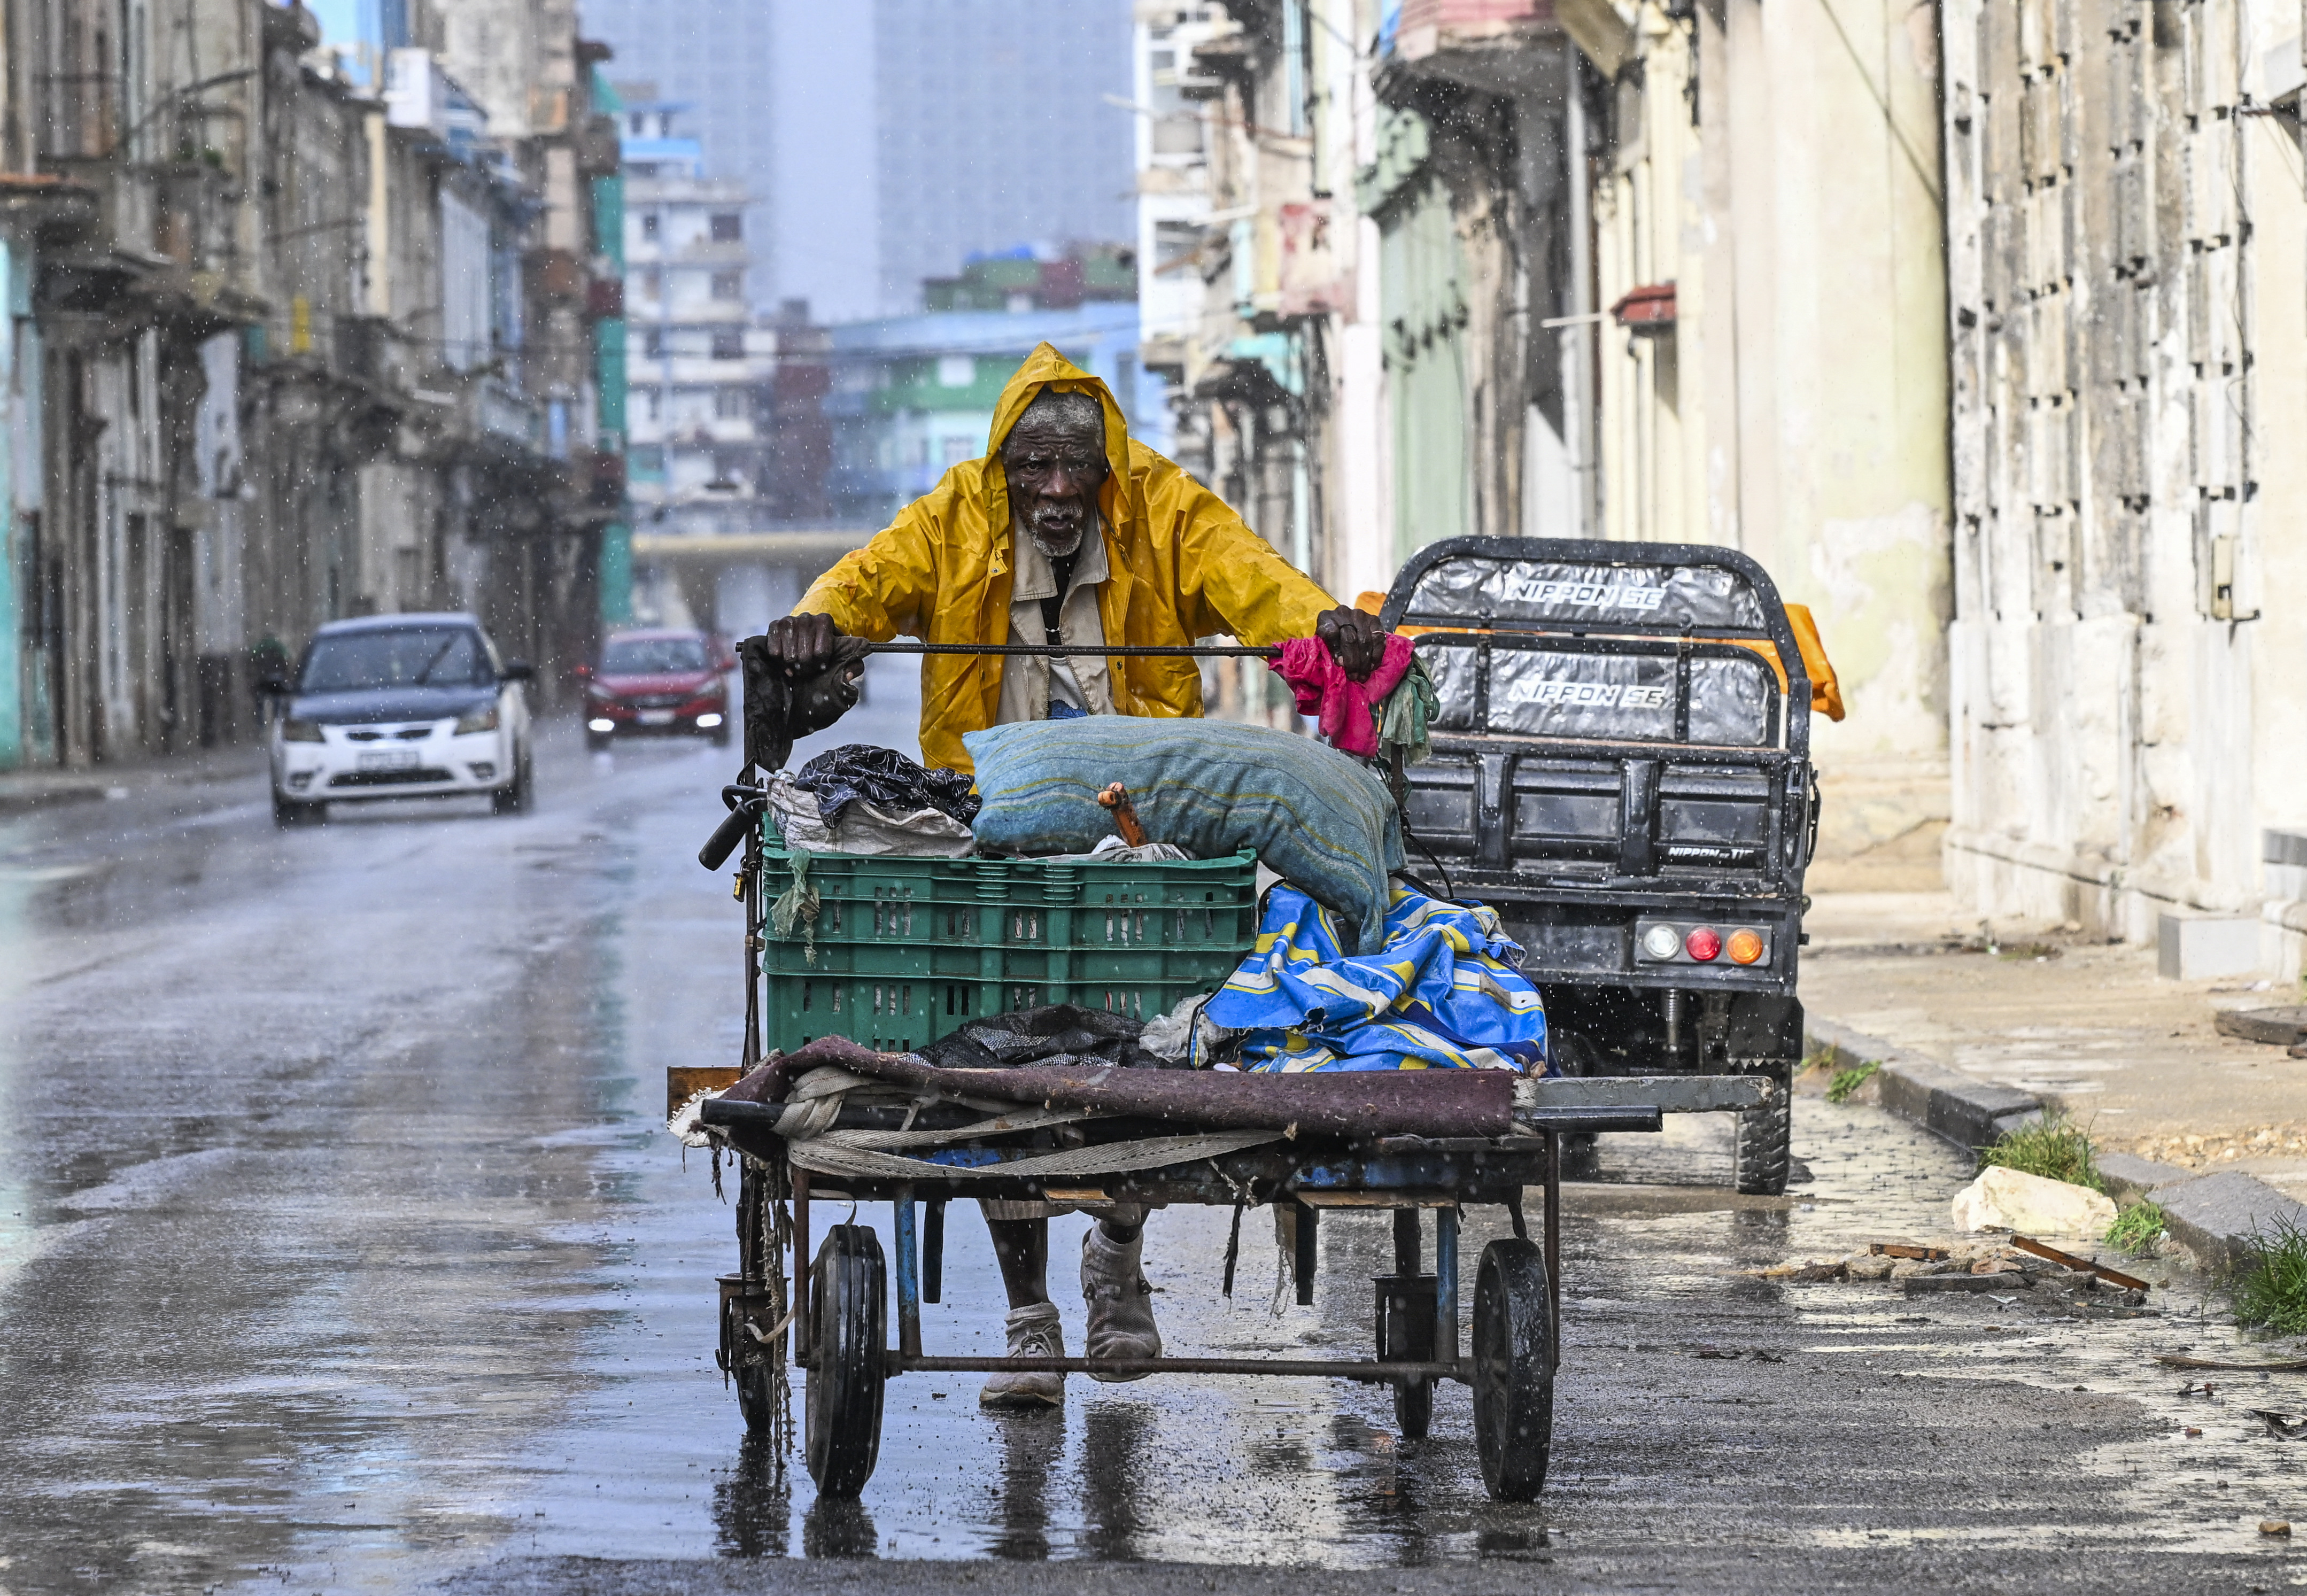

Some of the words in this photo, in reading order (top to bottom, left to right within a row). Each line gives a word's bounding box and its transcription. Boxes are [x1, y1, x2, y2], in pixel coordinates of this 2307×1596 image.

[1504, 579, 1620, 607] NIPPON
[1507, 679, 1622, 707] NIPPON
[1668, 847, 1720, 857] NIPPON
